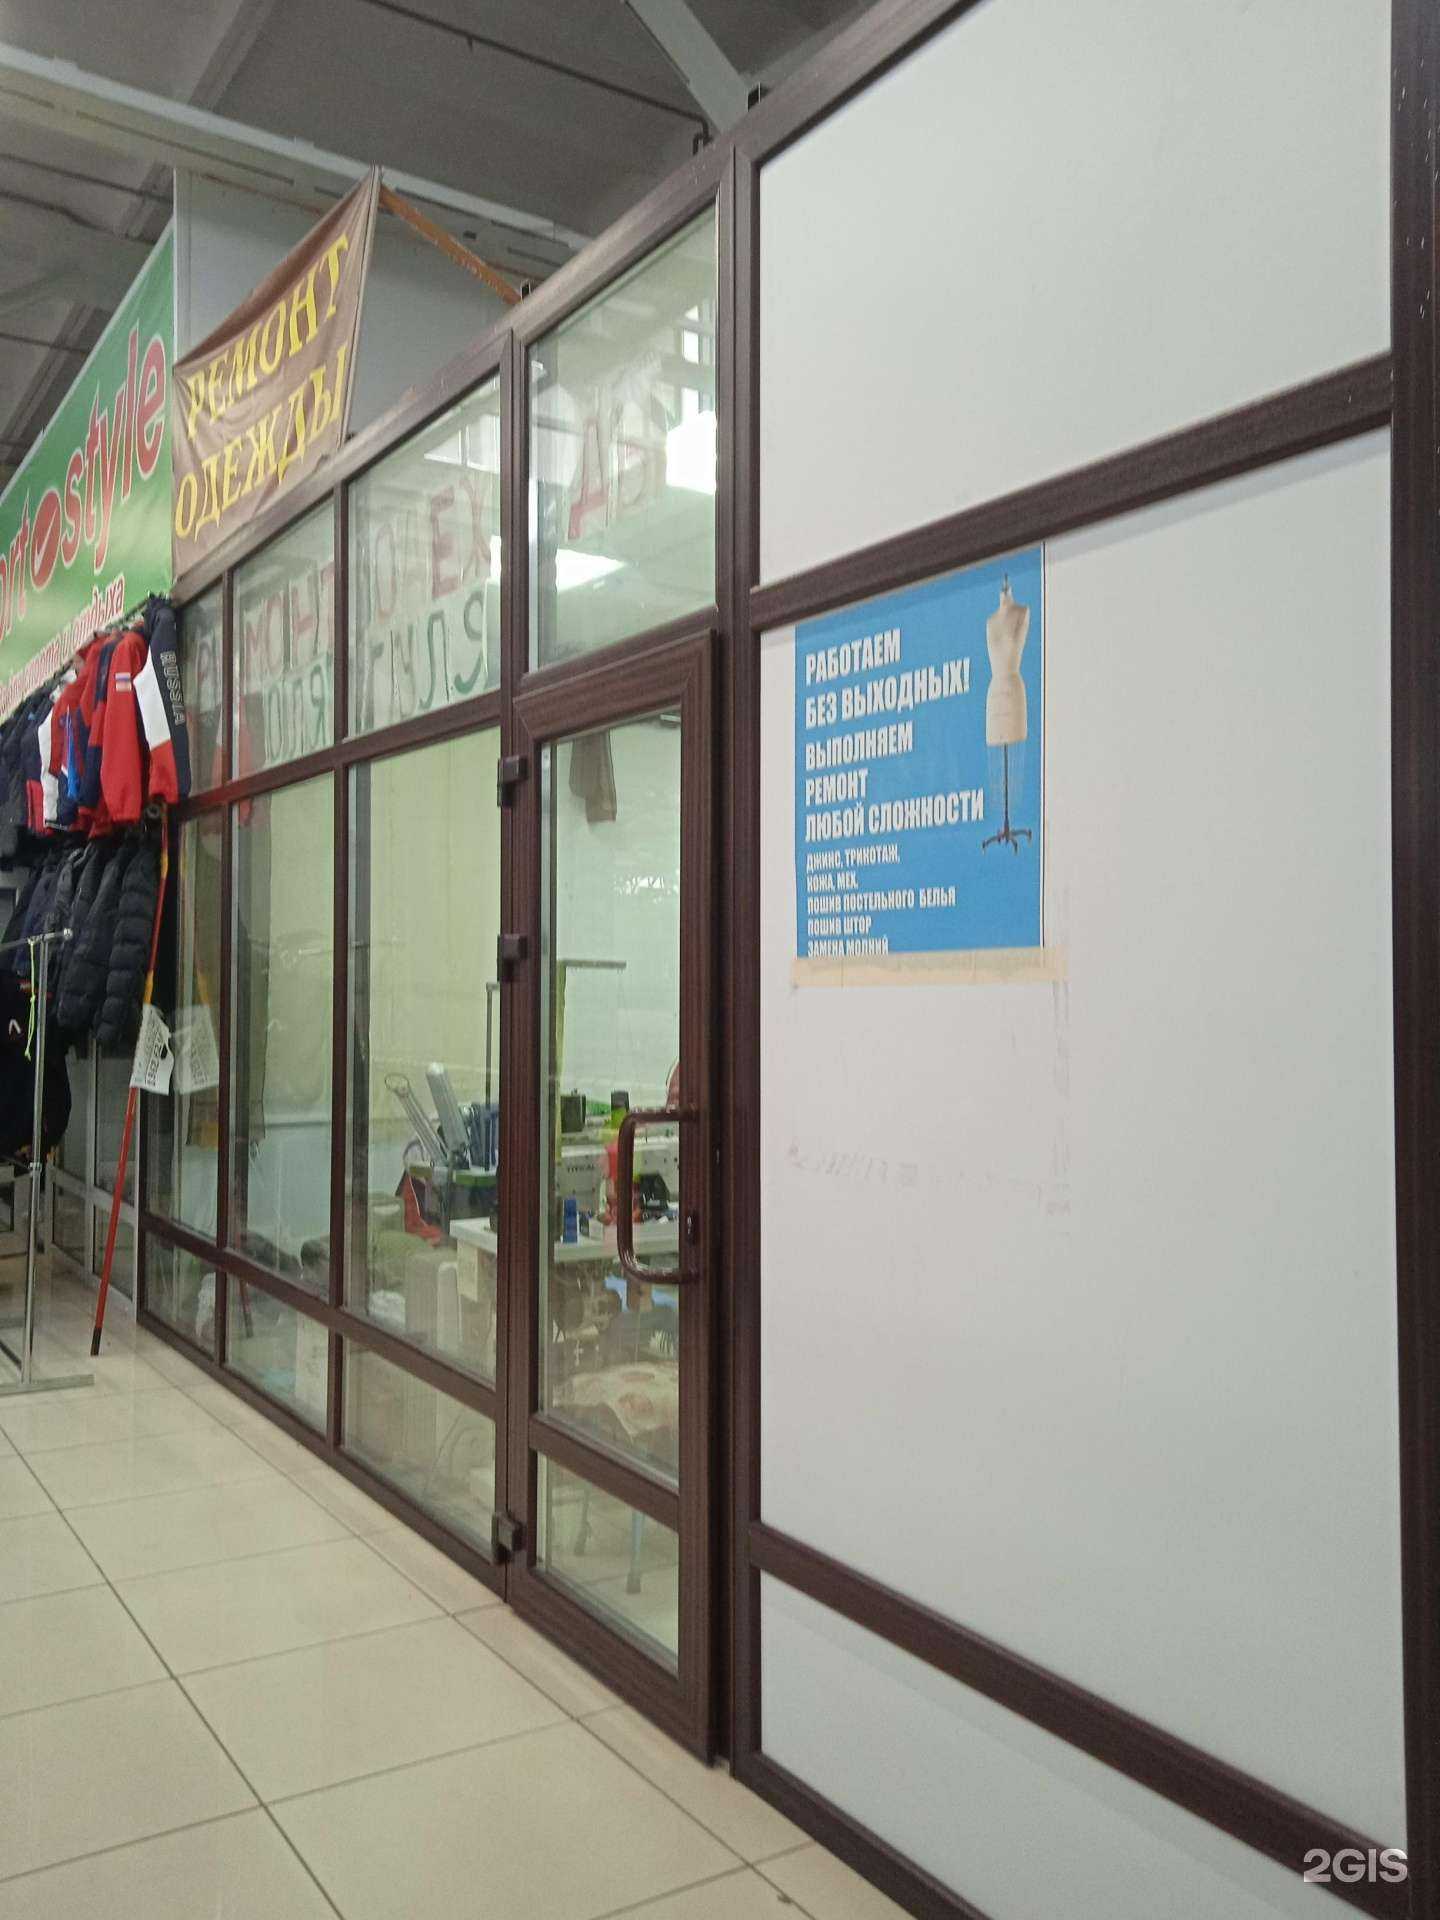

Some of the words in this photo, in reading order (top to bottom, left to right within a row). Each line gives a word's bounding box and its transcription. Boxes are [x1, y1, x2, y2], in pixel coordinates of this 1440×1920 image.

[187, 233, 349, 440] РЕМОНТ
[174, 344, 348, 542] ОДЕЖДЫ
[72, 571, 124, 651] отдыха
[805, 628, 901, 687] РАБОТАЕМ
[160, 651, 185, 726] RUSSIA
[805, 691, 837, 730] БЕЗ
[841, 657, 971, 721] ВЫХОДНЫХ!
[805, 720, 913, 771] ВЫПОЛНЯЕМ
[805, 767, 868, 807] РЕМОНТ
[805, 801, 865, 843] ЛЮБОЙ
[868, 787, 984, 835] СЛОЖНОСТИ
[807, 894, 842, 915] ПОШИВ
[844, 887, 915, 913] ПОСТЕЛЬНОГО
[919, 885, 956, 909] БЕЛЬЯ
[807, 915, 842, 938] ПОШИВ
[843, 914, 872, 935] ШТОР
[807, 938, 845, 957] ЗАМЕНА
[846, 934, 889, 957] МОЛНИЙ
